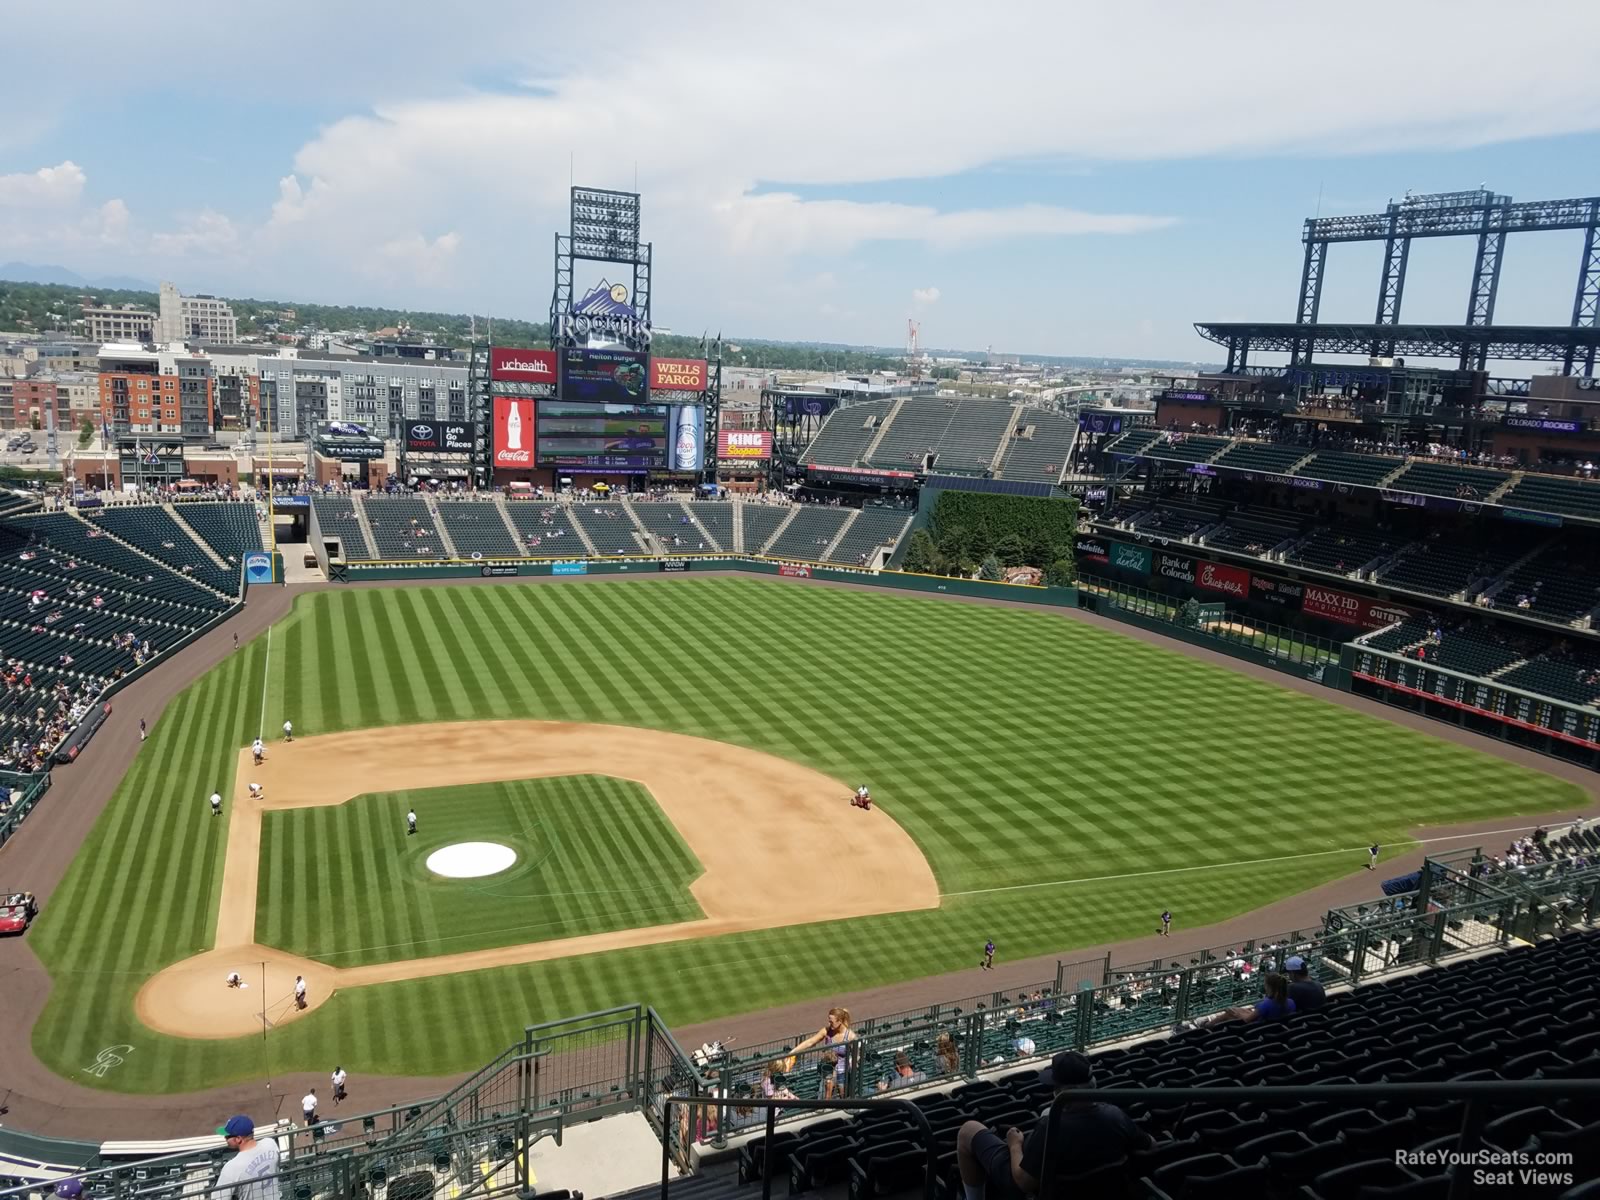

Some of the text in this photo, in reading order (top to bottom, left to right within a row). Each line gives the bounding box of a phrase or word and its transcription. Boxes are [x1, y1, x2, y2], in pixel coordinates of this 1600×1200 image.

[553, 313, 653, 345] ROCKIES
[501, 358, 548, 373] uchealth
[657, 363, 700, 375] WELLS
[657, 374, 700, 386] FARGO
[446, 426, 465, 434] Let's
[1507, 418, 1576, 431] COLORADO ROCKIES
[446, 433, 458, 441] Go
[728, 433, 763, 446] KING
[409, 440, 437, 448] TOYOTA
[446, 440, 472, 449] Places
[727, 444, 763, 457] Soopers
[326, 448, 383, 456] TUNDRA
[860, 475, 885, 484] ROCKIES
[1264, 475, 1320, 489] COLORADO ROCKIES
[1077, 541, 1105, 555] Safelite
[1116, 556, 1145, 571] dental
[1161, 555, 1190, 571] Bank of
[1160, 566, 1195, 582] Colorado
[1201, 564, 1243, 595] Chick-fil-A
[1305, 588, 1340, 606] MAXX
[1341, 596, 1359, 610] HD
[1370, 609, 1403, 623] OUTBA
[245, 1150, 276, 1176] GONZALEZ
